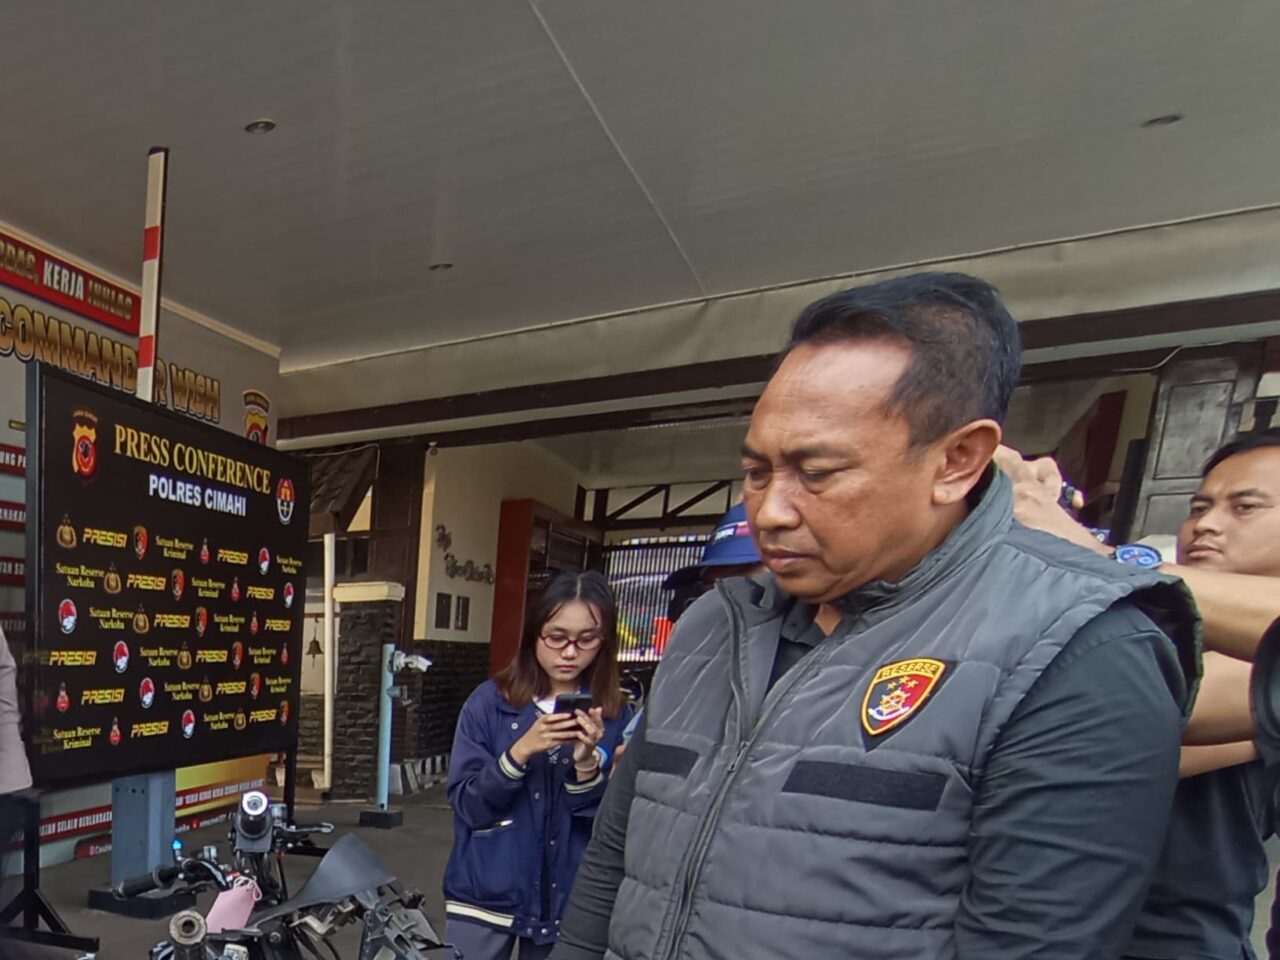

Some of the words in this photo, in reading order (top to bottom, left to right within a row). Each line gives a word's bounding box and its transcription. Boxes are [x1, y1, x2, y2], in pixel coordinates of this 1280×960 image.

[43, 260, 84, 300] KERJA
[170, 363, 220, 424] WISH
[114, 424, 170, 467] PRESS
[173, 443, 270, 494] CONFERENCE
[149, 474, 201, 507] POLRES
[204, 488, 246, 517] CIMAHI
[83, 528, 128, 549] PRESISI
[217, 549, 249, 565] PRESISI
[126, 573, 167, 591] PRESISI
[246, 586, 275, 600] PRESISI
[153, 613, 191, 628] PRESISI
[264, 619, 291, 632] PRESISI
[49, 650, 97, 666] PRESISI
[195, 650, 228, 663] PRESISI
[882, 663, 937, 676] RESERSE
[216, 681, 247, 695] PRESISI
[81, 688, 125, 706] PRESISI
[249, 709, 277, 723] PRESISI
[53, 728, 76, 740] Satuan
[131, 720, 169, 738] PRESISI
[63, 736, 92, 750] Kriminal
